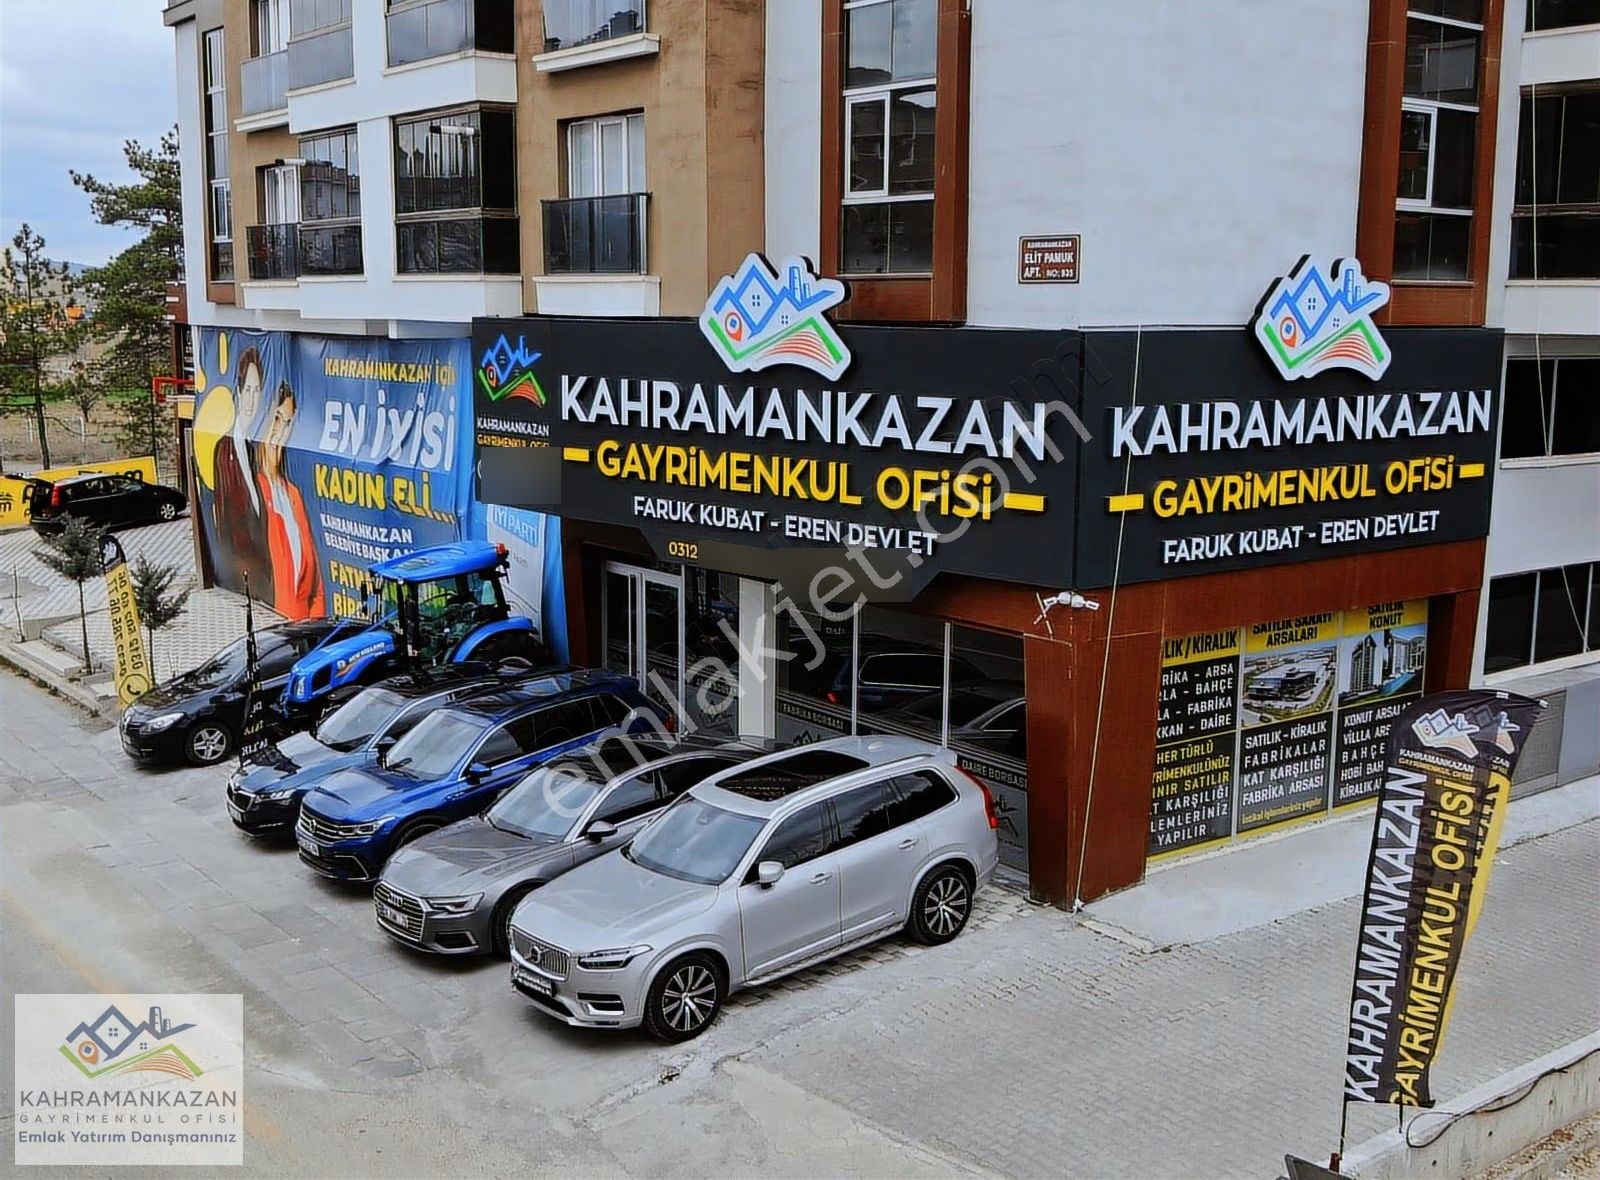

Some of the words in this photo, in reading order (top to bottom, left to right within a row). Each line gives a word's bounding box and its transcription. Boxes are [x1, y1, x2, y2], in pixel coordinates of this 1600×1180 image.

[319, 400, 367, 456] EN
[370, 389, 455, 472] İYİSİ
[477, 416, 550, 437] KAHRAMANKAZAN
[561, 374, 1046, 461] KAHRAMANKAZAN
[1112, 389, 1491, 458] KAHRAMANKAZAN
[315, 463, 385, 510] KADIN
[320, 512, 413, 543] KAHRAMANKAZAN
[634, 496, 693, 525] FARUK
[698, 503, 764, 532] KUBAT
[785, 514, 843, 542] EREN
[848, 525, 937, 556] DEVLET
[1163, 534, 1232, 564] FARUK
[1239, 526, 1303, 554] KUBAT
[1321, 518, 1368, 544] EREN
[1374, 511, 1440, 538] DEVLET
[324, 531, 362, 557] BELEDİYE
[668, 541, 698, 559] 0312
[1369, 612, 1403, 630] KONUT
[1193, 631, 1237, 654] KİRALIK
[1266, 626, 1318, 648] ARSALARI
[1162, 670, 1188, 686] RİKA
[1206, 663, 1234, 679] ARSA
[1196, 678, 1233, 695] BAHÇE
[1188, 696, 1232, 715] FABRİKA
[1344, 710, 1374, 727] KONUT
[1201, 713, 1231, 730] DAİRE
[1245, 730, 1281, 749] SATILIK
[1291, 720, 1327, 739] KİRALIK
[1157, 750, 1178, 765] HER
[1180, 739, 1214, 759] TÜRLÜ
[1245, 739, 1326, 768] FABRİKALAR
[1342, 742, 1386, 764] BAHÇE
[1184, 771, 1229, 791] SATILIR
[1244, 771, 1264, 787] KAT
[1270, 755, 1324, 780] KARŞILIĞI
[1341, 762, 1363, 781] HOBİ
[1149, 802, 1160, 816] T
[1166, 784, 1228, 812] KARŞILIĞI
[1243, 784, 1284, 806] FABRİKA
[1289, 775, 1323, 795] ARSASI
[1340, 779, 1372, 799] KİRALIK
[1150, 802, 1228, 833] LEMLERİNİZ
[1432, 777, 1476, 870] OFİSİ
[1158, 824, 1206, 846] YAPILIR
[1344, 766, 1427, 1103] KAHRAMANKAZAN
